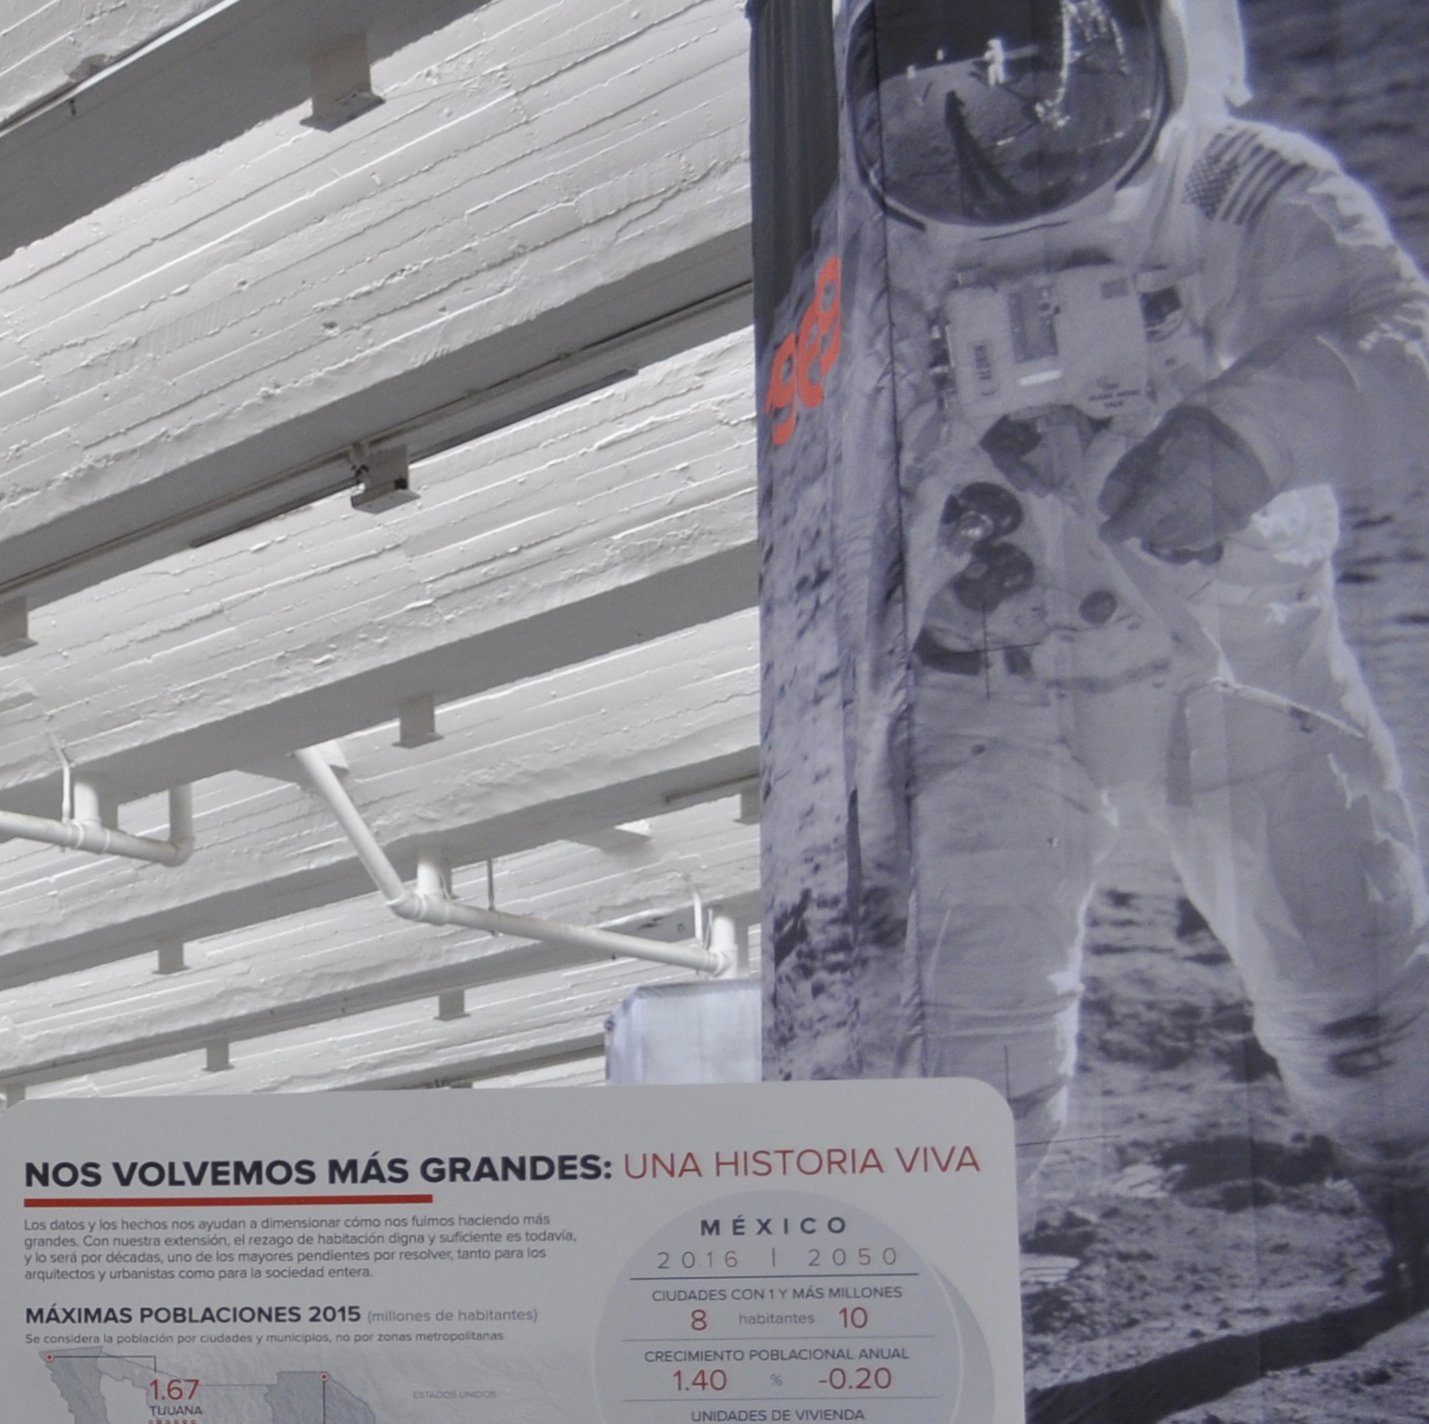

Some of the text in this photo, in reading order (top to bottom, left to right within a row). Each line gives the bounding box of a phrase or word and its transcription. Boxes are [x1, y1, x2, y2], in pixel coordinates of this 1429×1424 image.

[25, 1146, 981, 1188] NOS VOLVEMOS MÁS GRANDES: UNA HISTORIA VIVA
[24, 1212, 551, 1233] Los datos y los hechos nos ayudan a dimensionar cómo nos fuimos haciendo más
[700, 1213, 846, 1236] MÉXICO
[657, 1247, 897, 1269] 2016 2050
[651, 1285, 903, 1302] CIUDADES CON 1 Y MÁS MILLONES
[26, 1302, 538, 1325] MÁXIMAS POBLACIONES 2015 (millones de habitantes)
[691, 1306, 868, 1331] 8 habitantes 10
[644, 1348, 910, 1363] CRECIMIENTO POBLACIONAL ANUAL
[149, 1378, 200, 1401] 1.67
[673, 1369, 728, 1392] 1.40
[818, 1367, 892, 1390] -0.20
[691, 1408, 866, 1423] UNIDADES DE VIVIENDA
